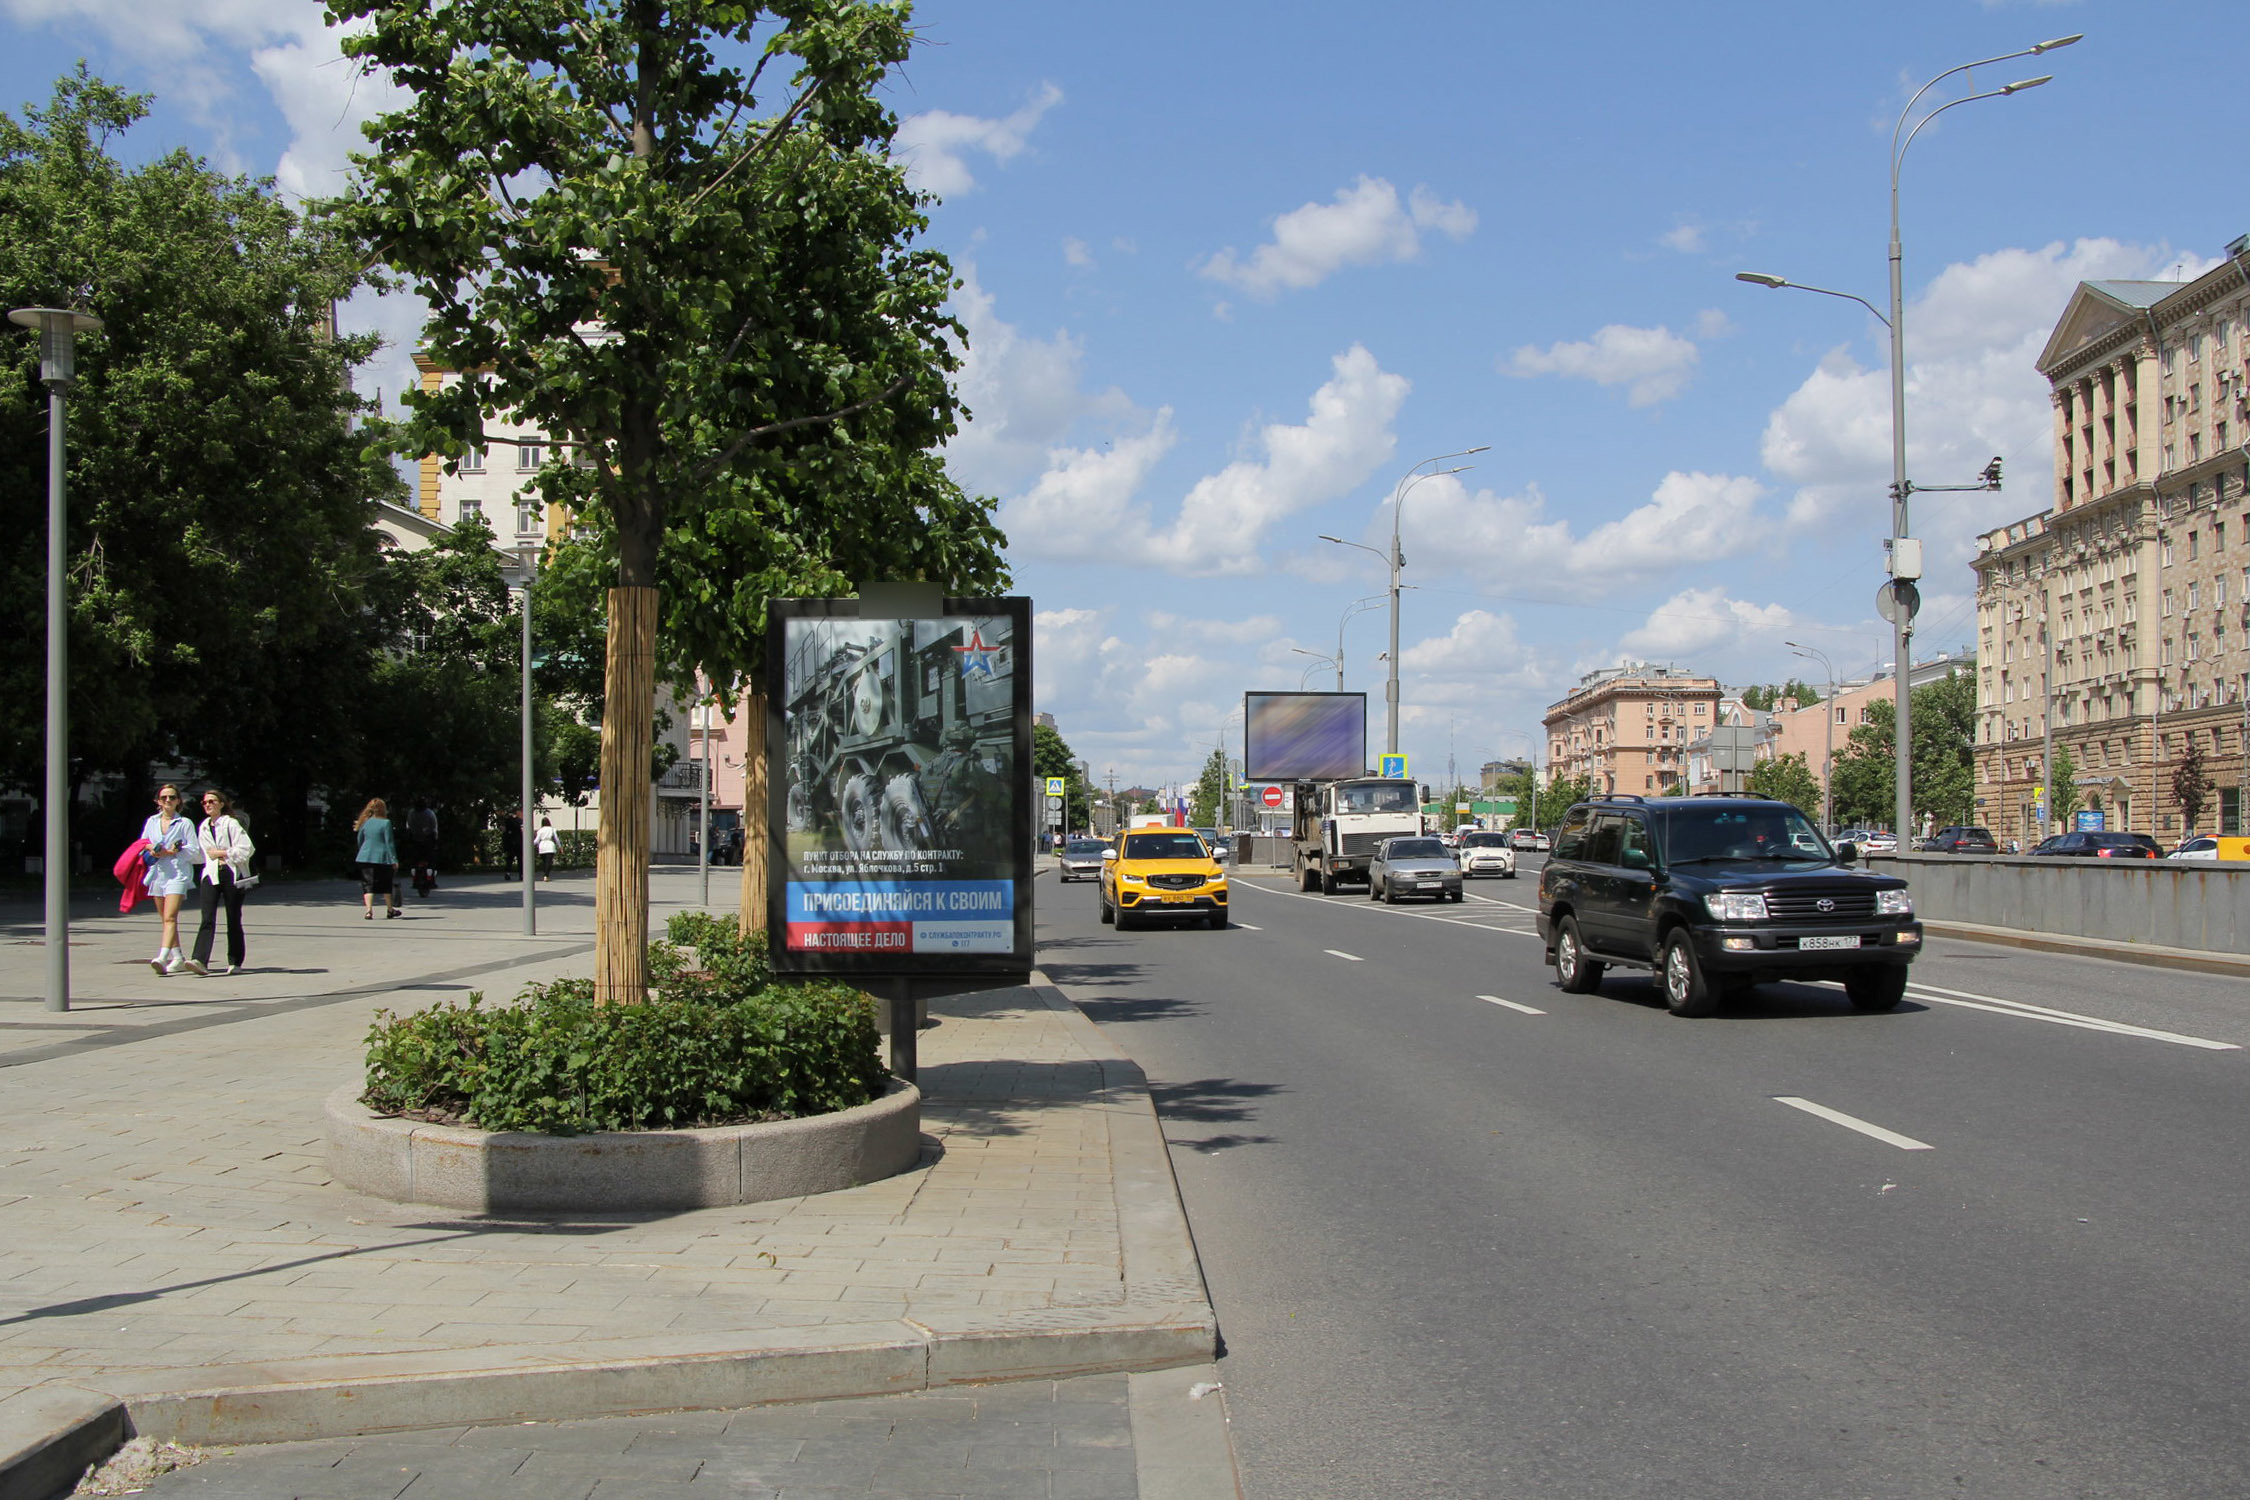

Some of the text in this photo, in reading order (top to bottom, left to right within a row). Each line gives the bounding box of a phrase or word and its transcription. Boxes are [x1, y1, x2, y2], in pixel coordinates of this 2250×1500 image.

[803, 849, 964, 861] ПУНКТ ОТБОРА НА СЛУЖБУ ПО КОНТРАКТУ:
[811, 864, 845, 874] Москва,
[858, 863, 905, 874] Яблочкова,
[920, 863, 937, 874] стр.
[938, 862, 943, 872] 1
[803, 889, 1002, 912] ПРИСОЕДИНЯЙСЯ К СВОИМ
[803, 932, 906, 948] НАСТОЯЩЕЕ ДЕЛО
